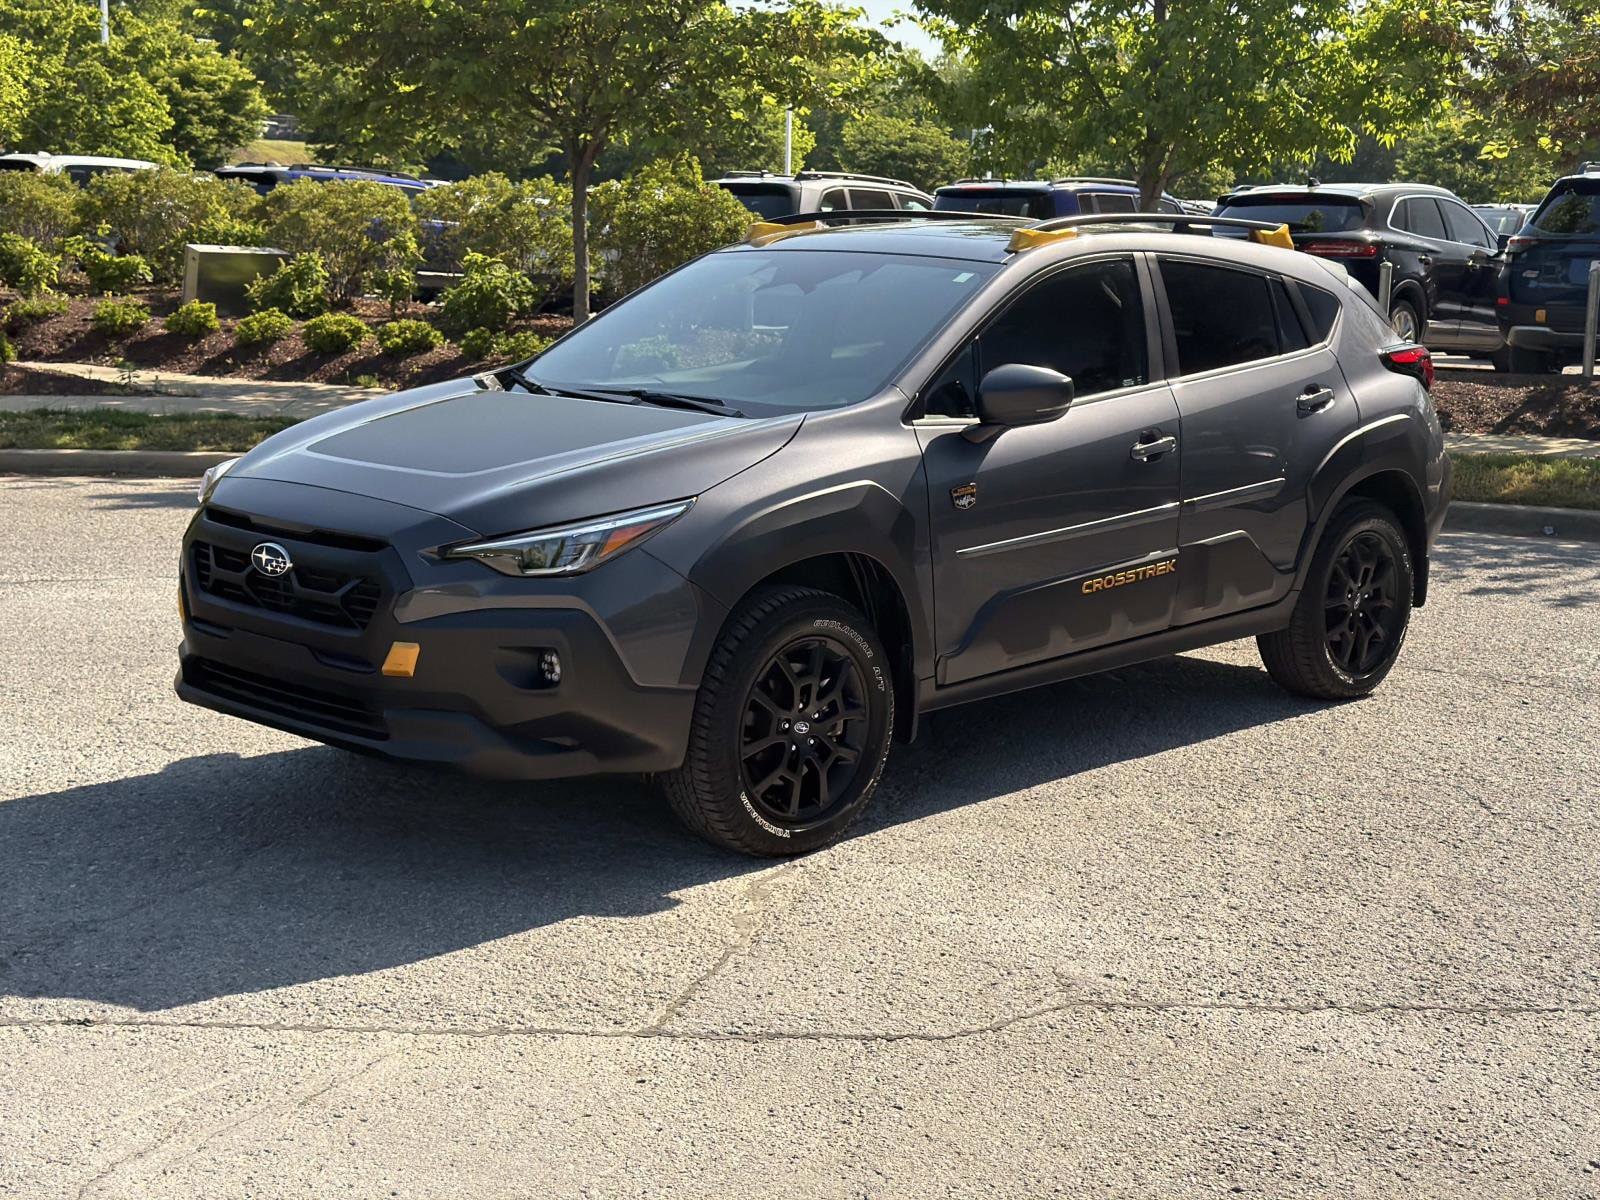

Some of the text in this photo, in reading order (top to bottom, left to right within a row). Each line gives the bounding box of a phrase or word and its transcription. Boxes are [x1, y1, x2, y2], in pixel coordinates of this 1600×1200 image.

[1082, 559, 1176, 594] CROSSTREK
[813, 619, 873, 658] GEOLANDAR
[740, 791, 791, 839] YOKOHAMA
